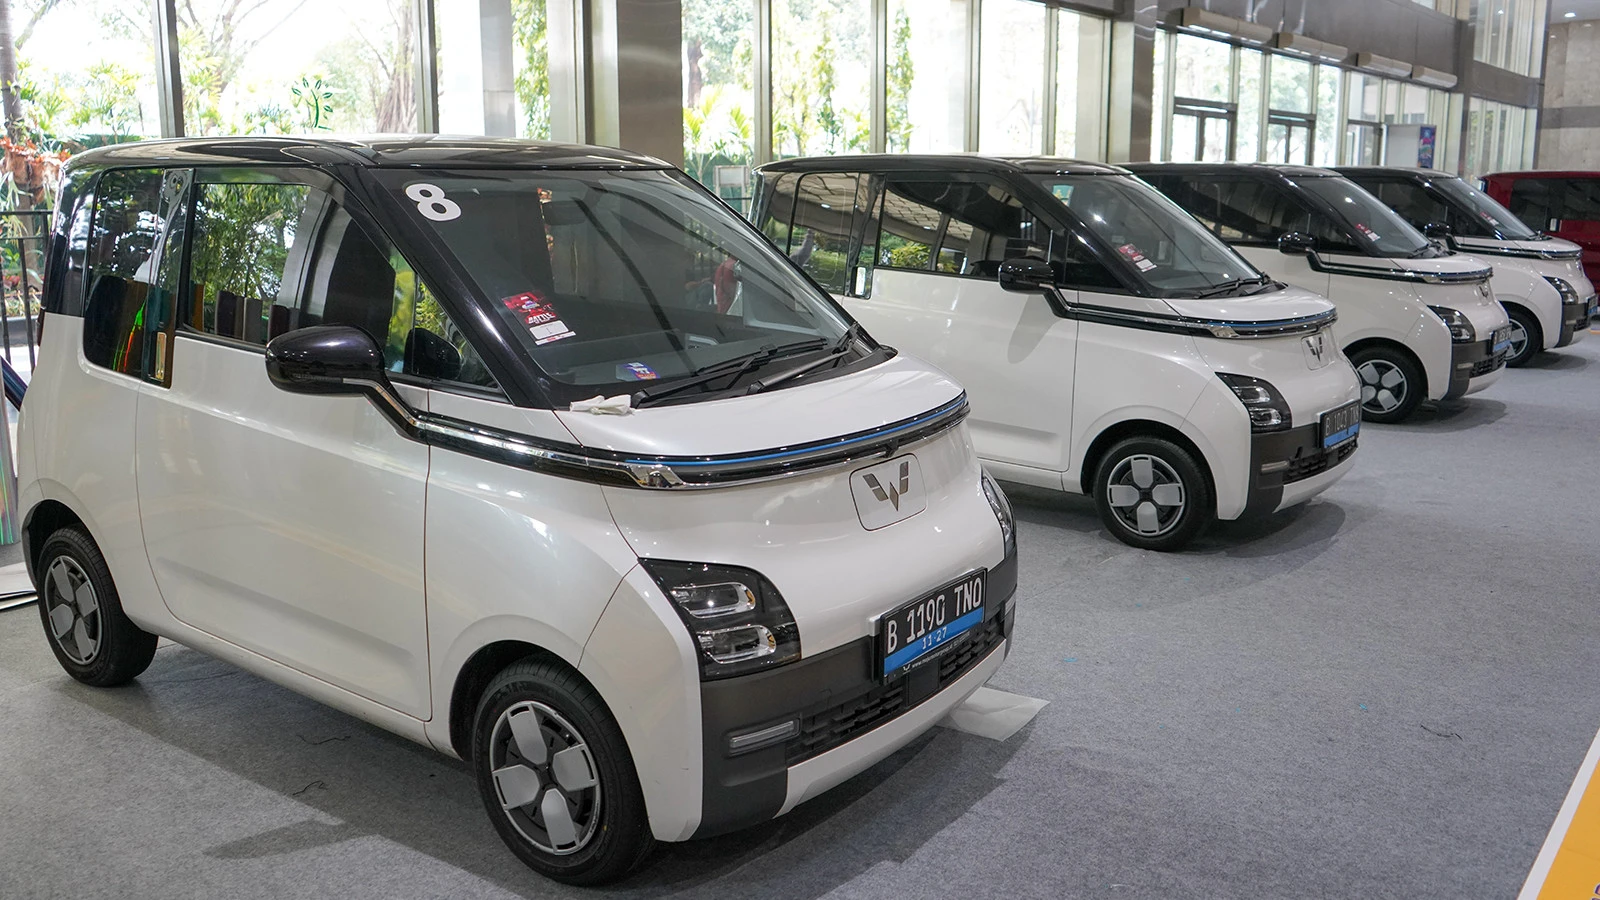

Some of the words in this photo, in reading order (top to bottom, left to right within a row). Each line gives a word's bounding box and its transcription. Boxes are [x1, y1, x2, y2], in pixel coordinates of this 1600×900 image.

[405, 183, 462, 222] 8
[1325, 416, 1331, 436] B
[887, 619, 898, 654] B
[906, 594, 945, 643] 1190
[954, 577, 982, 617] TNO
